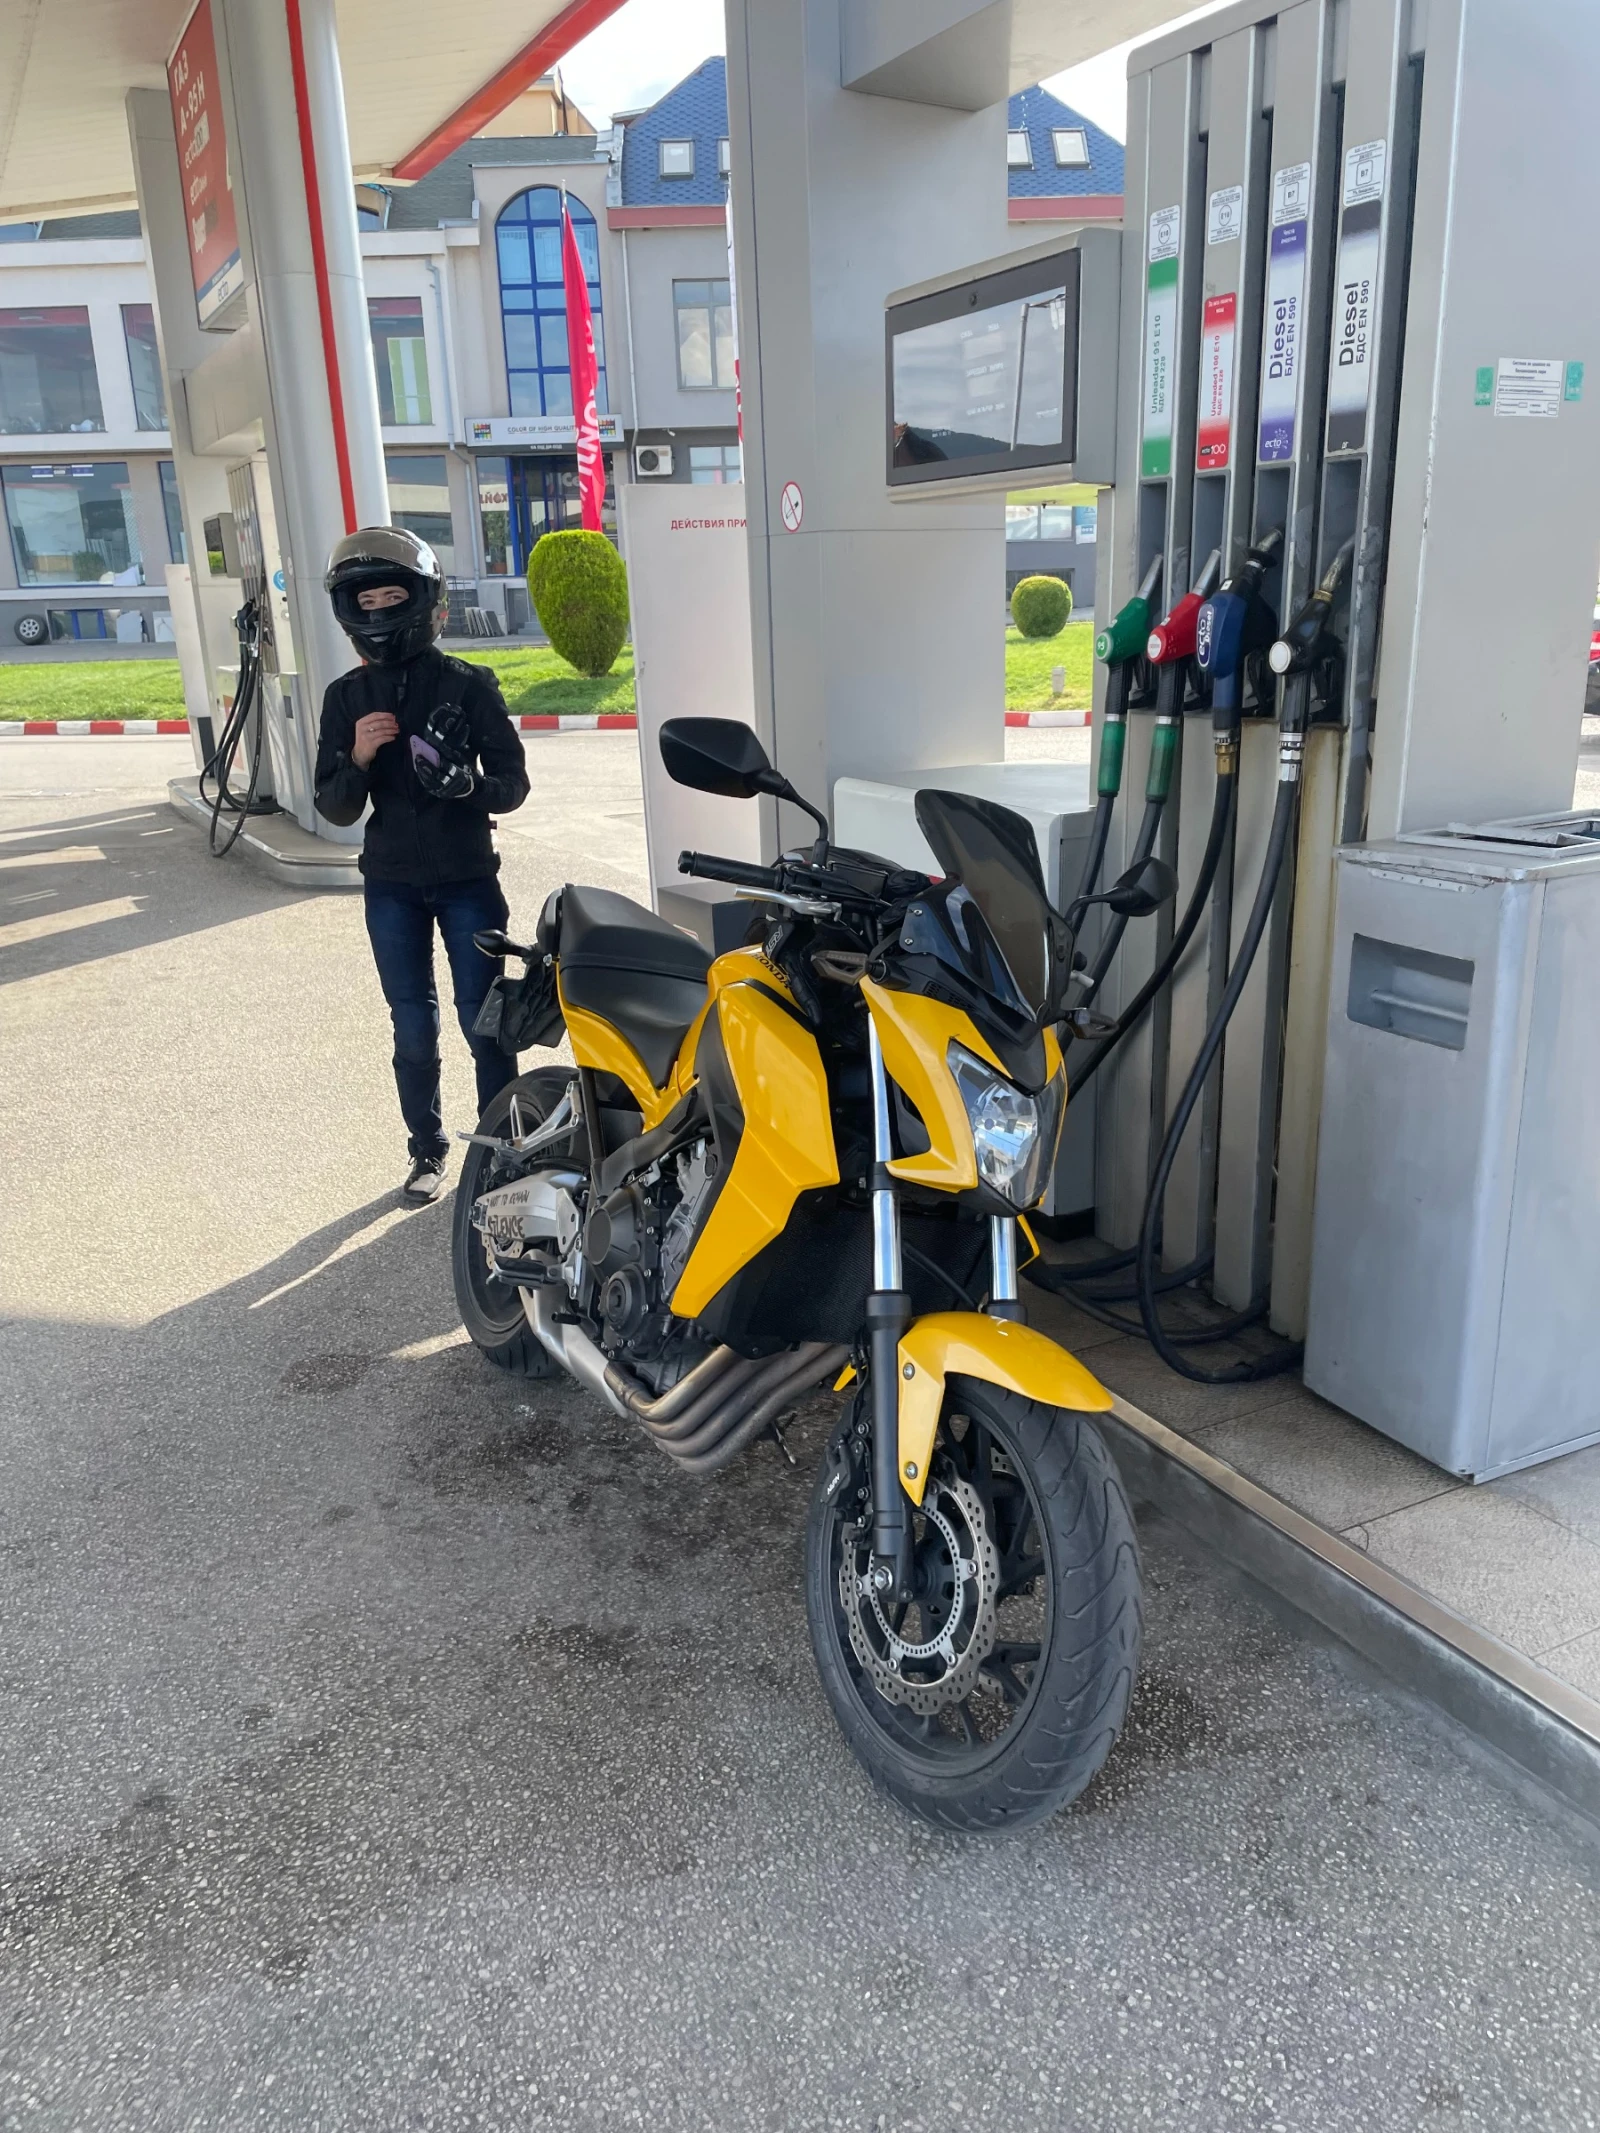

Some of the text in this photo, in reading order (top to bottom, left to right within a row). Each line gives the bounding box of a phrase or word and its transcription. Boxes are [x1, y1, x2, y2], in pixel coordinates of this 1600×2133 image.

[174, 49, 189, 96] ГАЗ
[1361, 169, 1369, 177] B7
[1288, 190, 1295, 198] B7
[1339, 282, 1358, 366] Diesel
[1356, 280, 1370, 364] БДС EN 590
[1153, 340, 1160, 355] 95
[1269, 298, 1287, 379] Diesel
[1284, 296, 1297, 377] БДС EN 590
[1152, 358, 1160, 414] Unleaded
[1160, 376, 1165, 390] EN
[1218, 384, 1223, 396] EN
[1265, 437, 1282, 448] ecto
[670, 517, 747, 530] ДЕЙСТВИЯ ПРИ
[1204, 610, 1213, 643] Diesel
[1097, 641, 1105, 650] 95
[750, 953, 791, 989] HONDA
[487, 1214, 525, 1239] SILENCE
